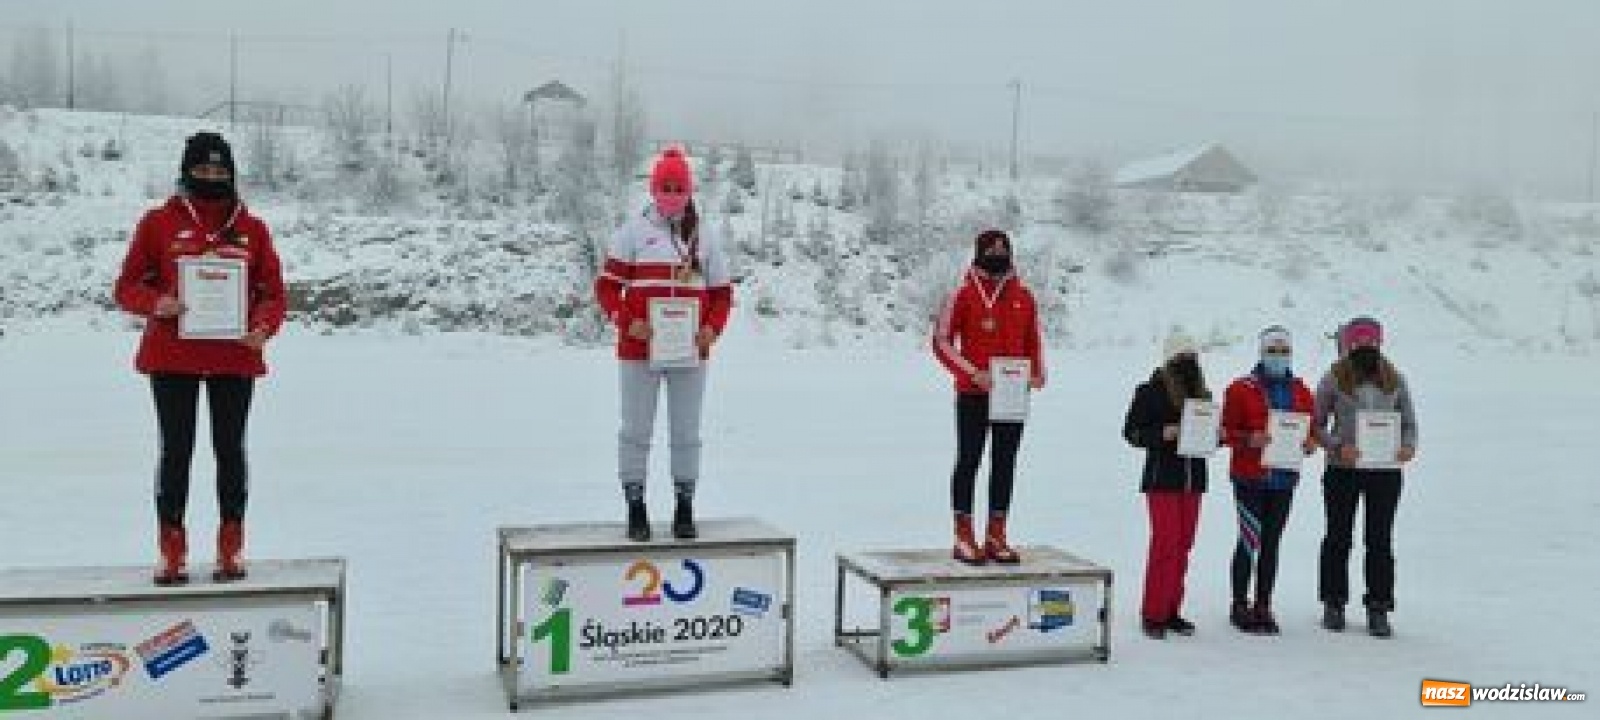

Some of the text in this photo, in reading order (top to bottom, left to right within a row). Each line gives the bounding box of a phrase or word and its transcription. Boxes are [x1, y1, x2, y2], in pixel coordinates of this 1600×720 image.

[531, 608, 571, 674] 1
[580, 615, 744, 650] Śląskie 2020
[891, 597, 934, 656] 3
[0, 635, 52, 710] 2
